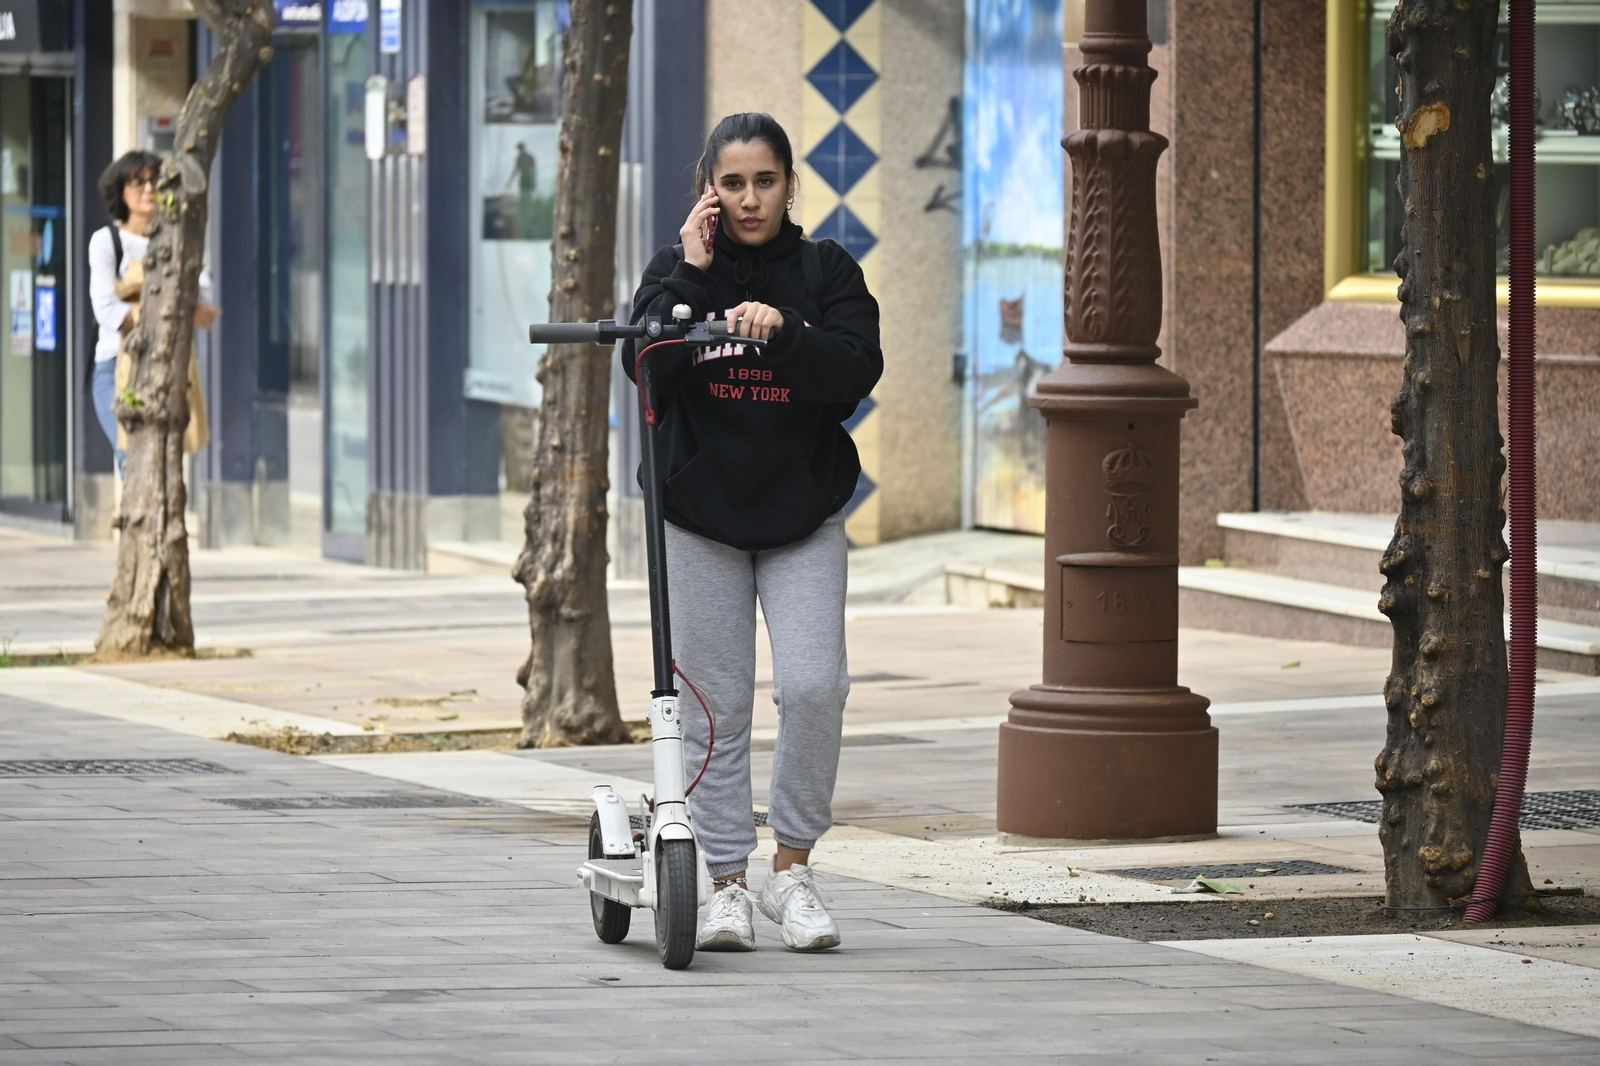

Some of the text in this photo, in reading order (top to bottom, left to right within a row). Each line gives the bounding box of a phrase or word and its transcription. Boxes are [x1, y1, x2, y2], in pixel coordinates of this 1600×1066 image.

[727, 367, 773, 381] 1898
[709, 382, 791, 403] NEW YORK
